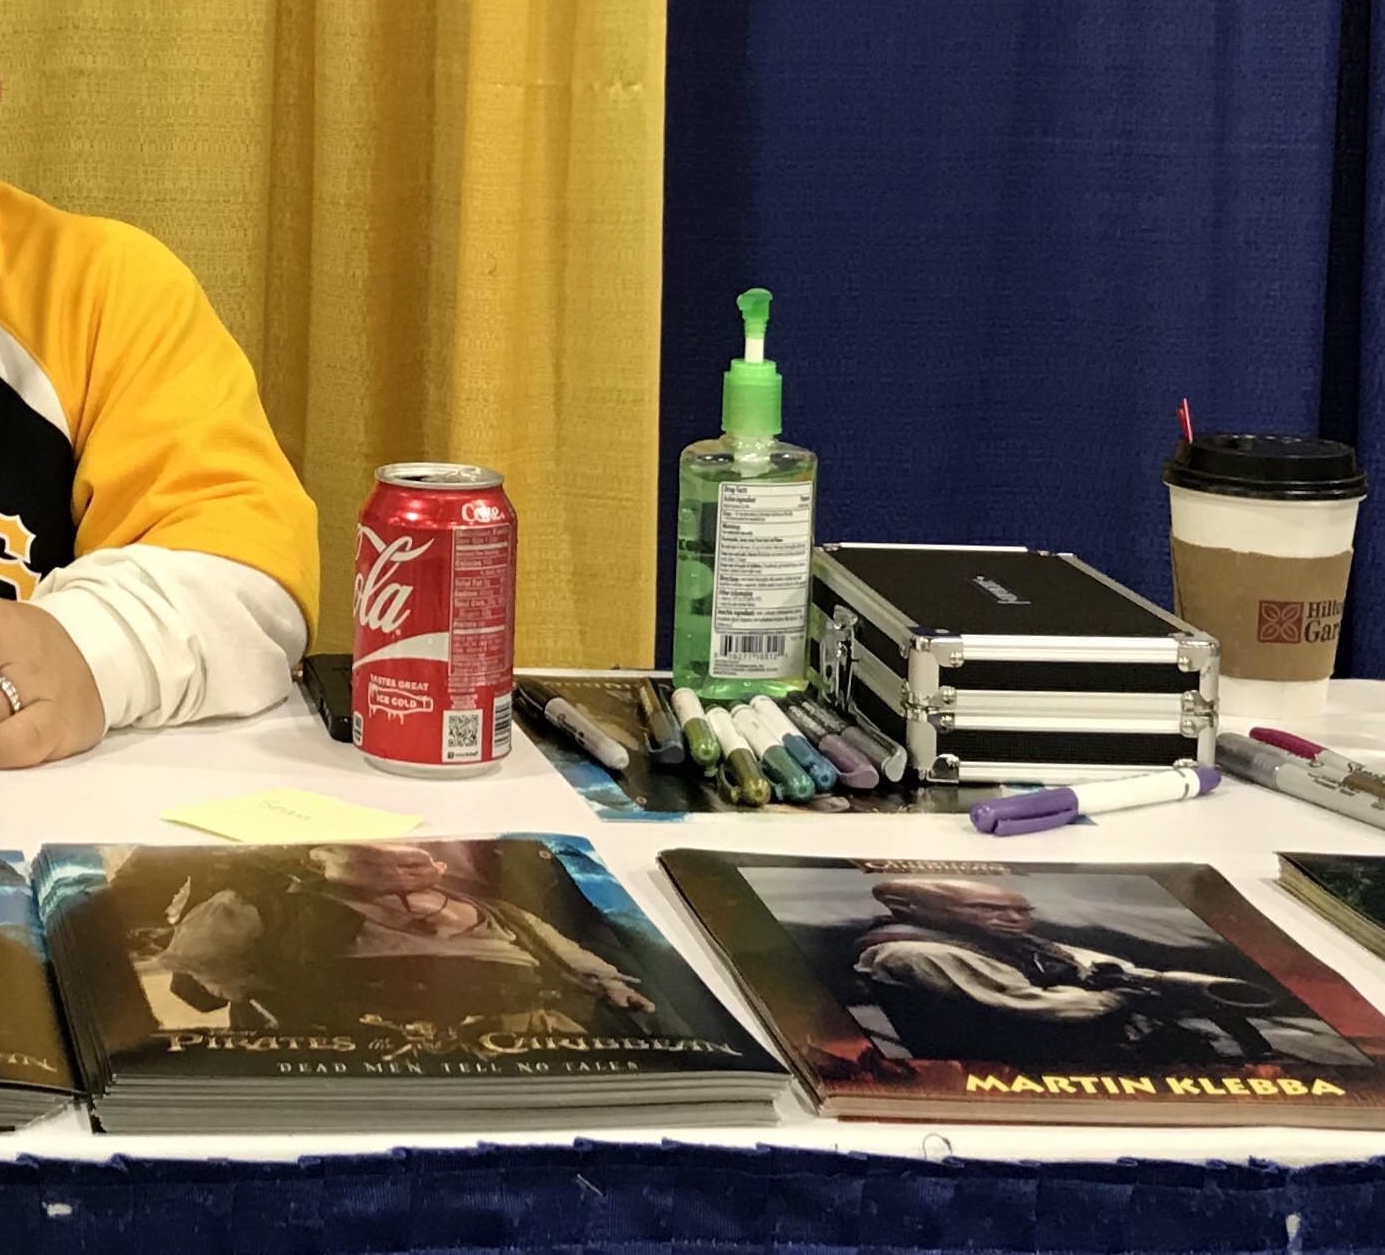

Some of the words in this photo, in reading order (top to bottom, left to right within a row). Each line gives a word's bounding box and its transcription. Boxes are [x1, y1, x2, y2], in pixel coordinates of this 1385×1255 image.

[398, 680, 429, 692] GREAT
[376, 694, 390, 704] ICE
[391, 696, 417, 708] COLD
[149, 1032, 357, 1052] PIRATES
[276, 1061, 348, 1074] DEAD
[363, 1060, 424, 1074] MEN
[440, 1062, 503, 1073] TELL
[516, 1061, 550, 1073] NO
[564, 1061, 640, 1072] TALES
[965, 1073, 1157, 1094] MARTIN
[1165, 1076, 1347, 1097] KLEBBA
